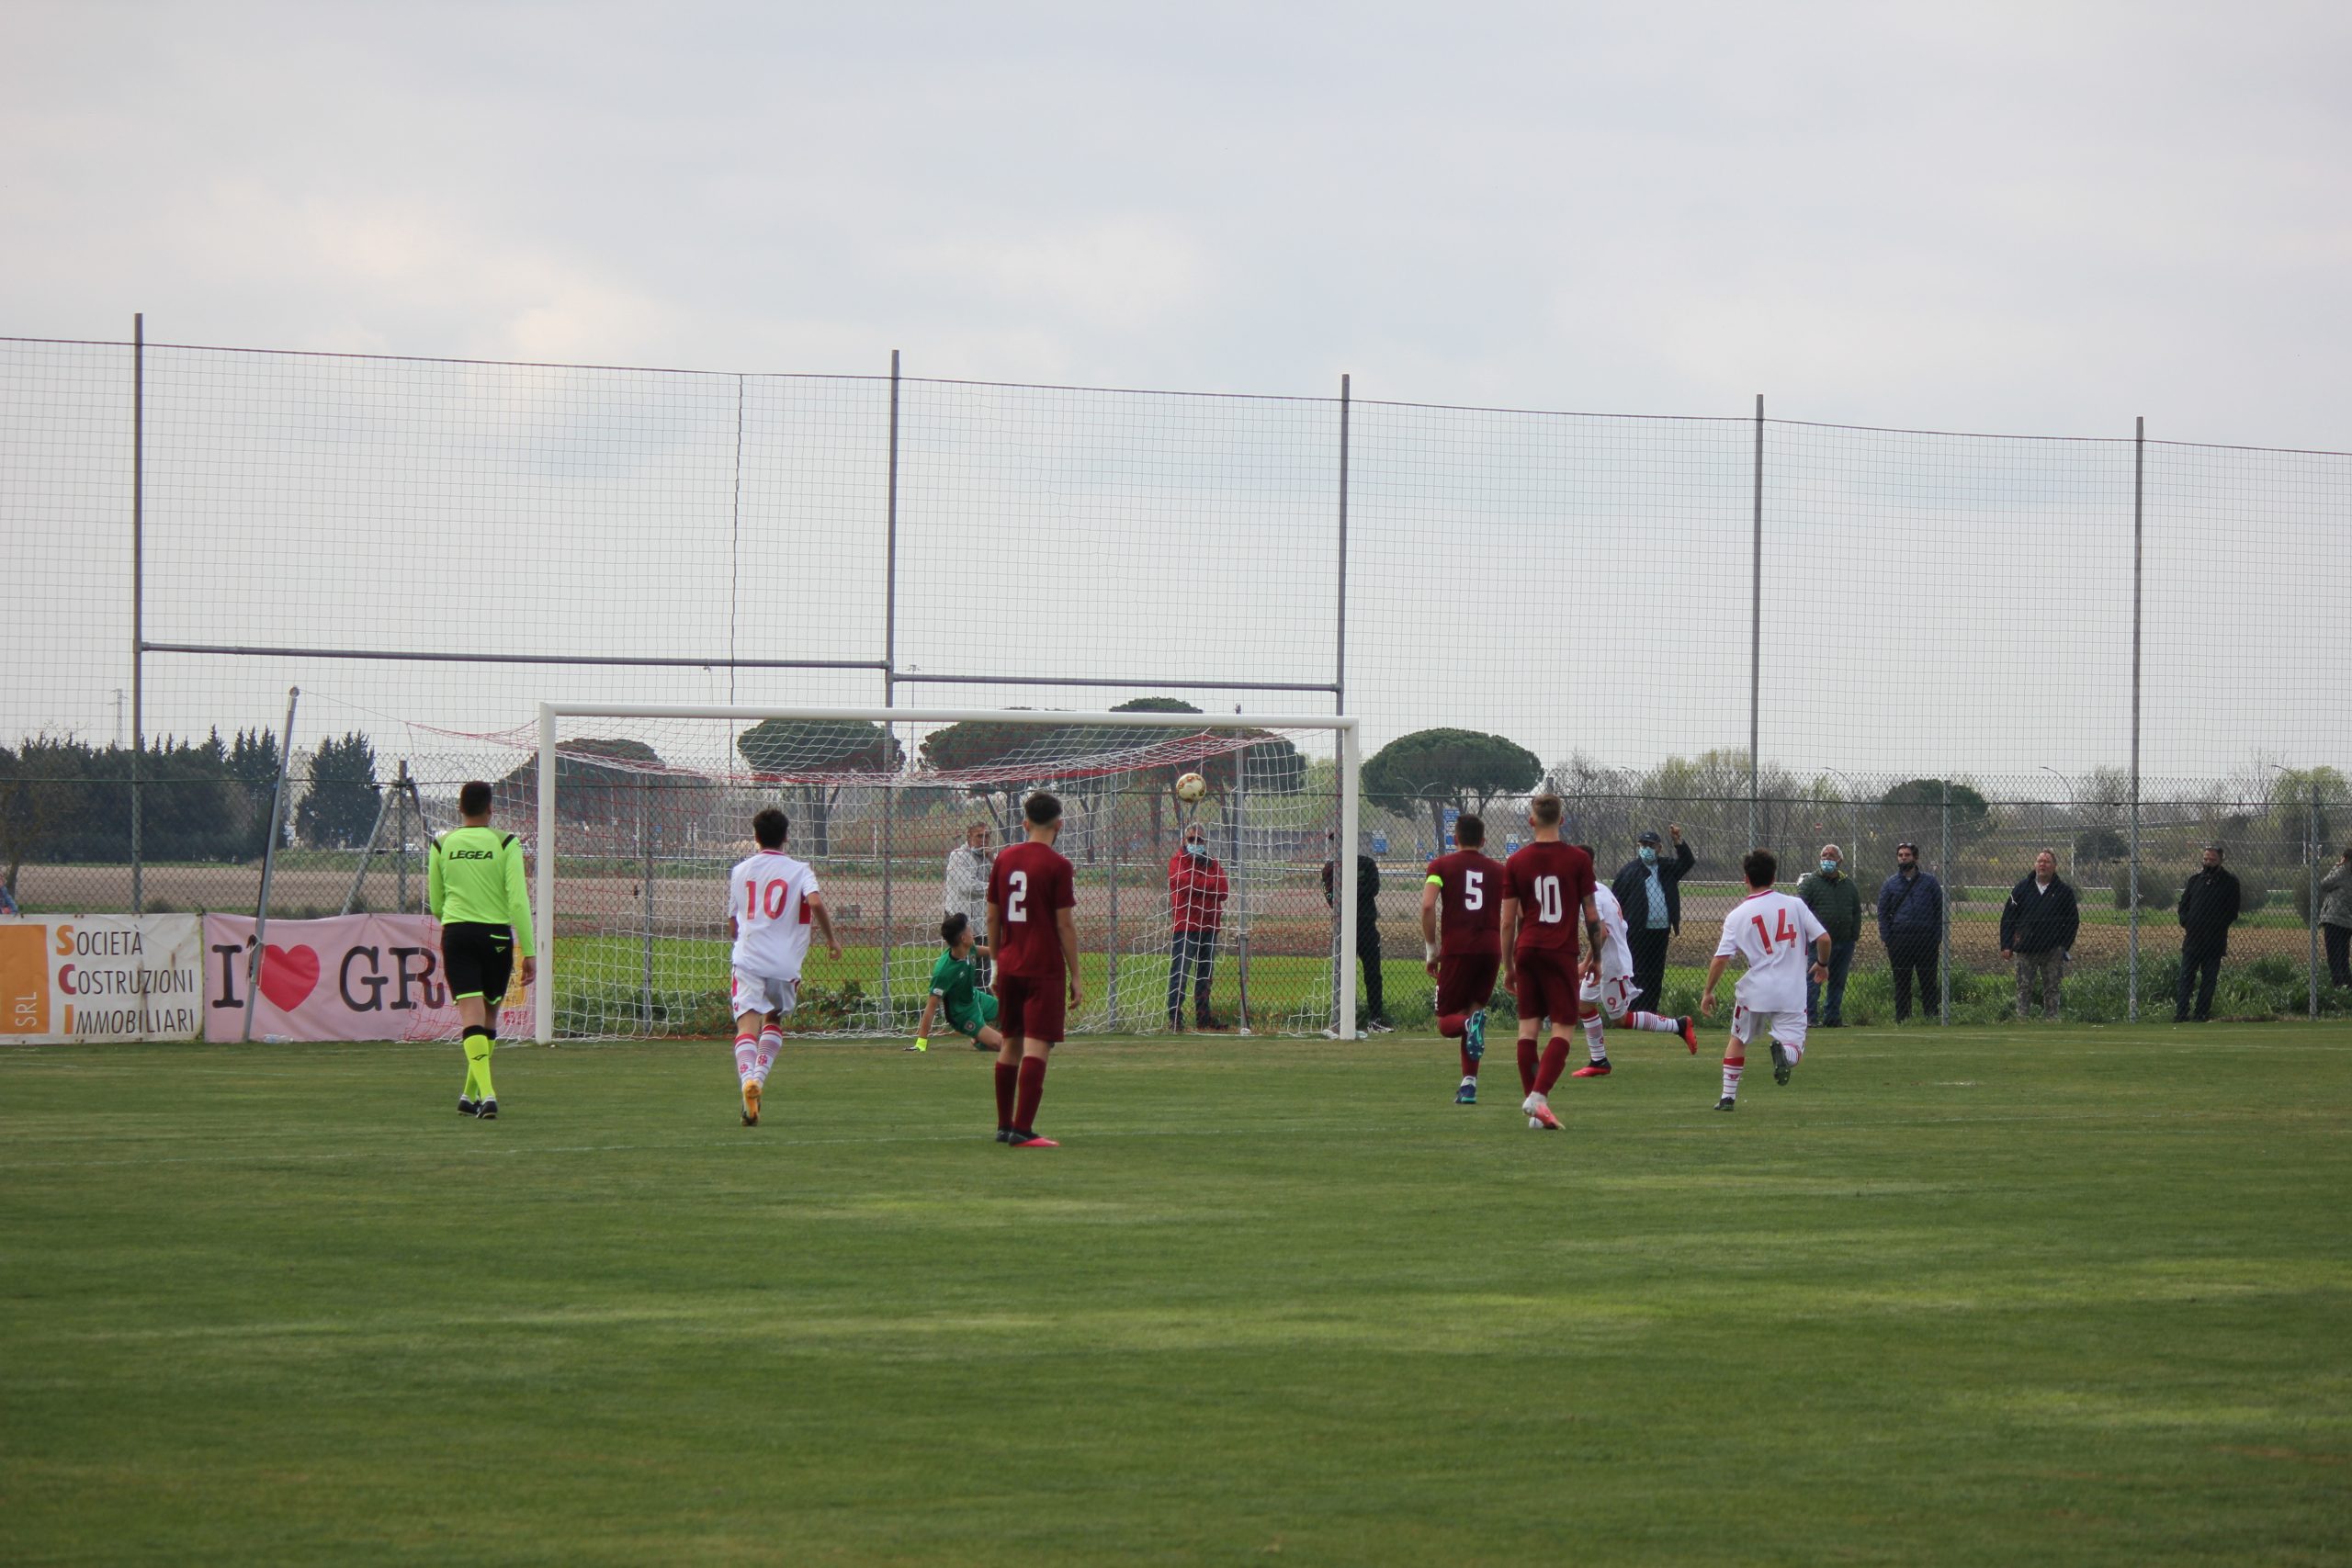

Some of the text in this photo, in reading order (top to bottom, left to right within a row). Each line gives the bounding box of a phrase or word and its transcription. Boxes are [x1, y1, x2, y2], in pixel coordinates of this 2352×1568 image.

[448, 850, 494, 861] LEGEA
[745, 878, 789, 920] 10
[1007, 870, 1028, 922] 2
[1464, 869, 1484, 911] 5
[1534, 874, 1563, 924] 10
[56, 924, 143, 956] SOCIETÀ
[1751, 908, 1798, 955] 14
[58, 963, 194, 996] COSTRUZIONI
[211, 943, 244, 1009] I
[15, 991, 38, 1028] SRL
[63, 1003, 195, 1035] IMMOBILIARI
[1606, 996, 1617, 1010] 9
